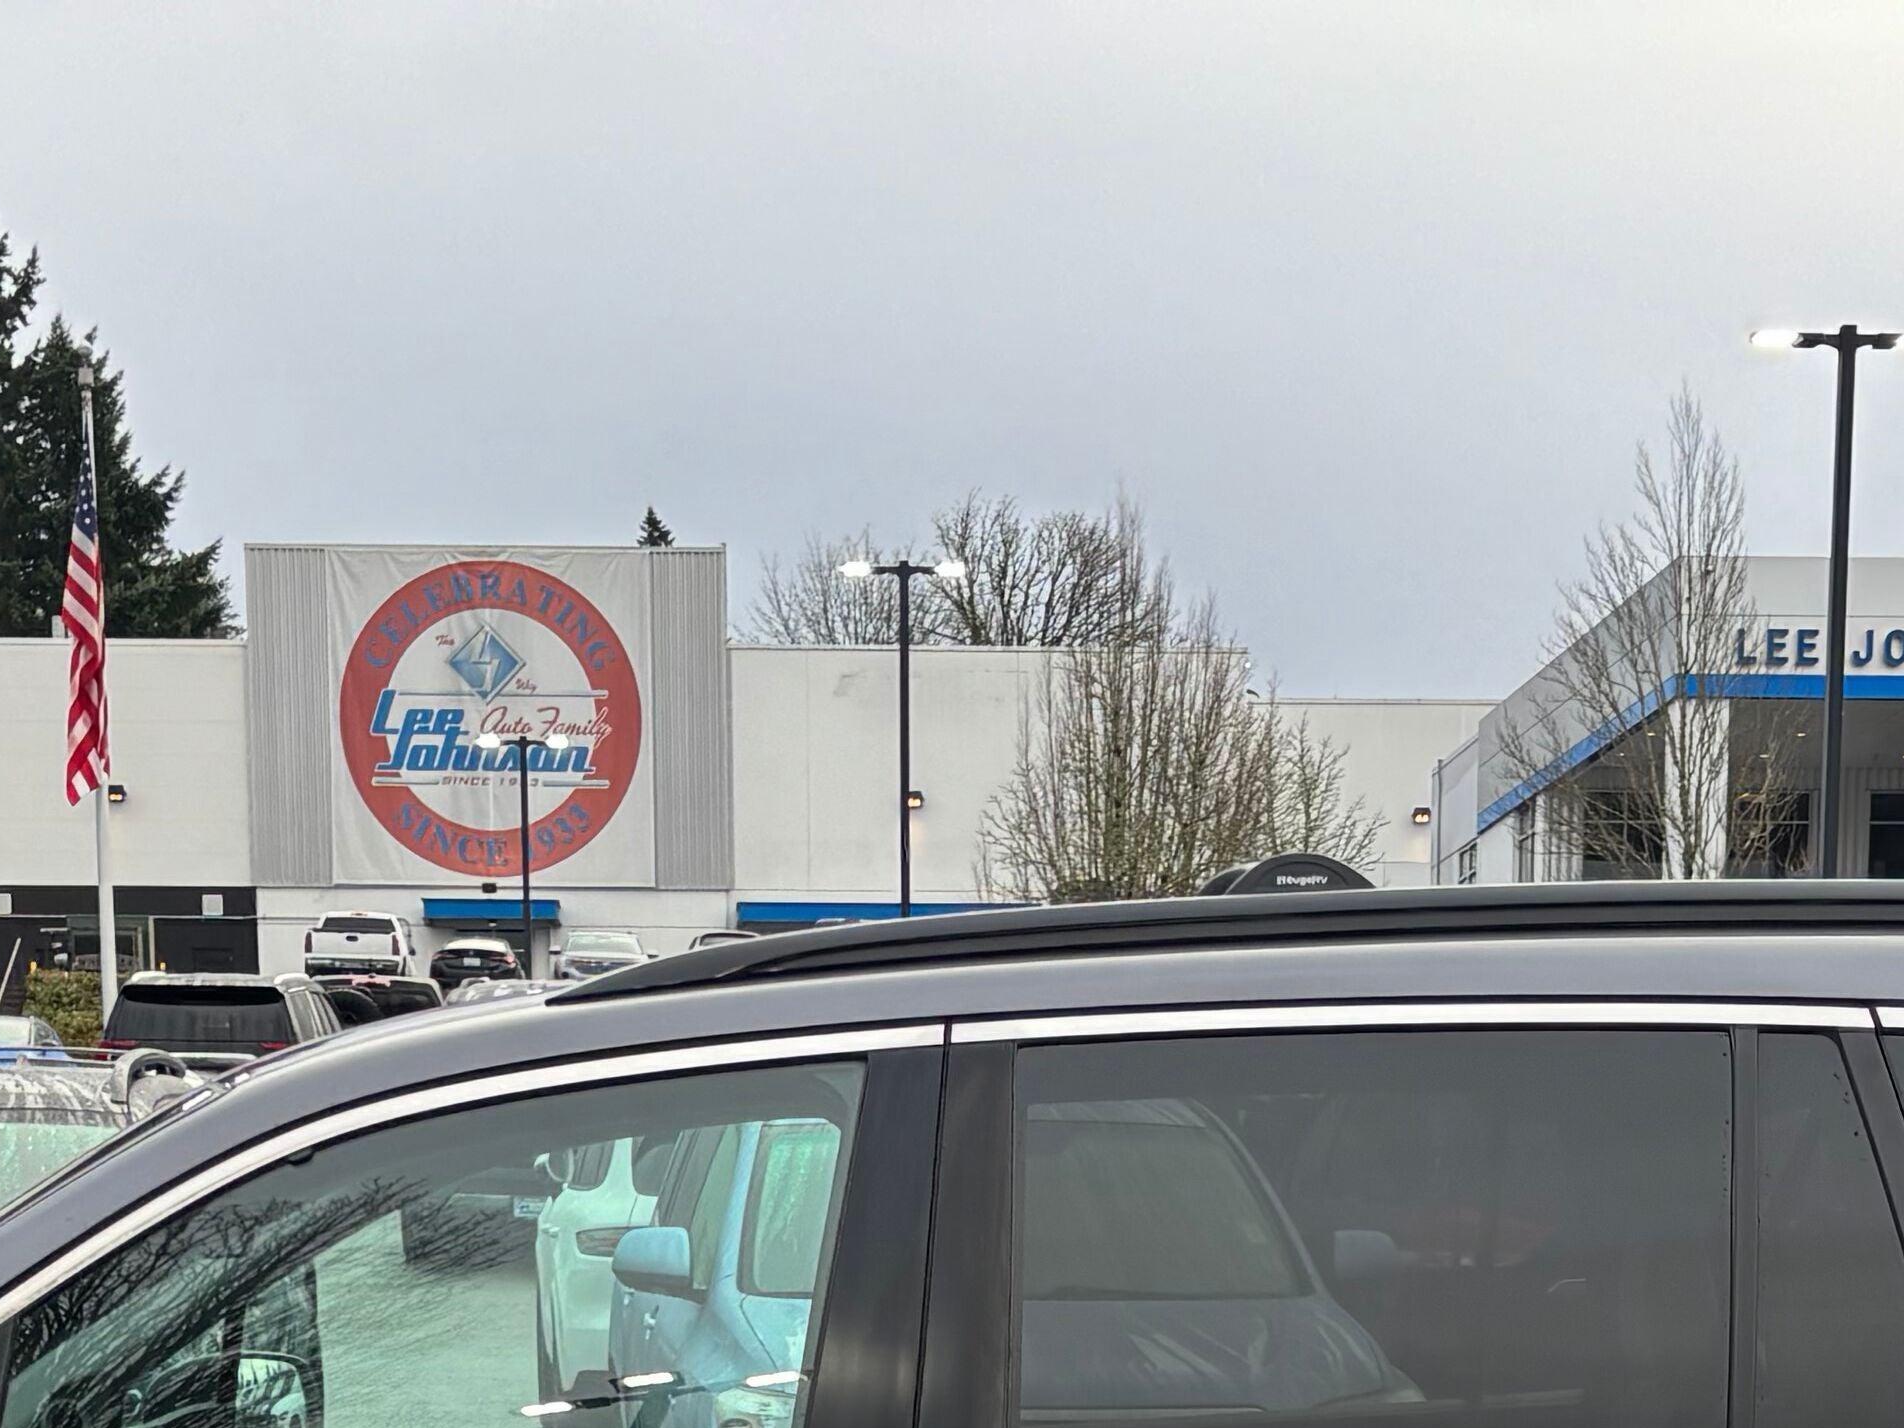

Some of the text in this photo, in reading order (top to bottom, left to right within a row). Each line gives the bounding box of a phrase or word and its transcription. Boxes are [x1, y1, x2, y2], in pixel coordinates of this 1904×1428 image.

[364, 571, 615, 670] CELEBRATING
[1735, 628, 1821, 666] LEE
[370, 690, 613, 749] Lee Auto Family
[376, 727, 596, 774] Johnson
[441, 776, 490, 786] SINCE
[395, 803, 507, 867] SINCE
